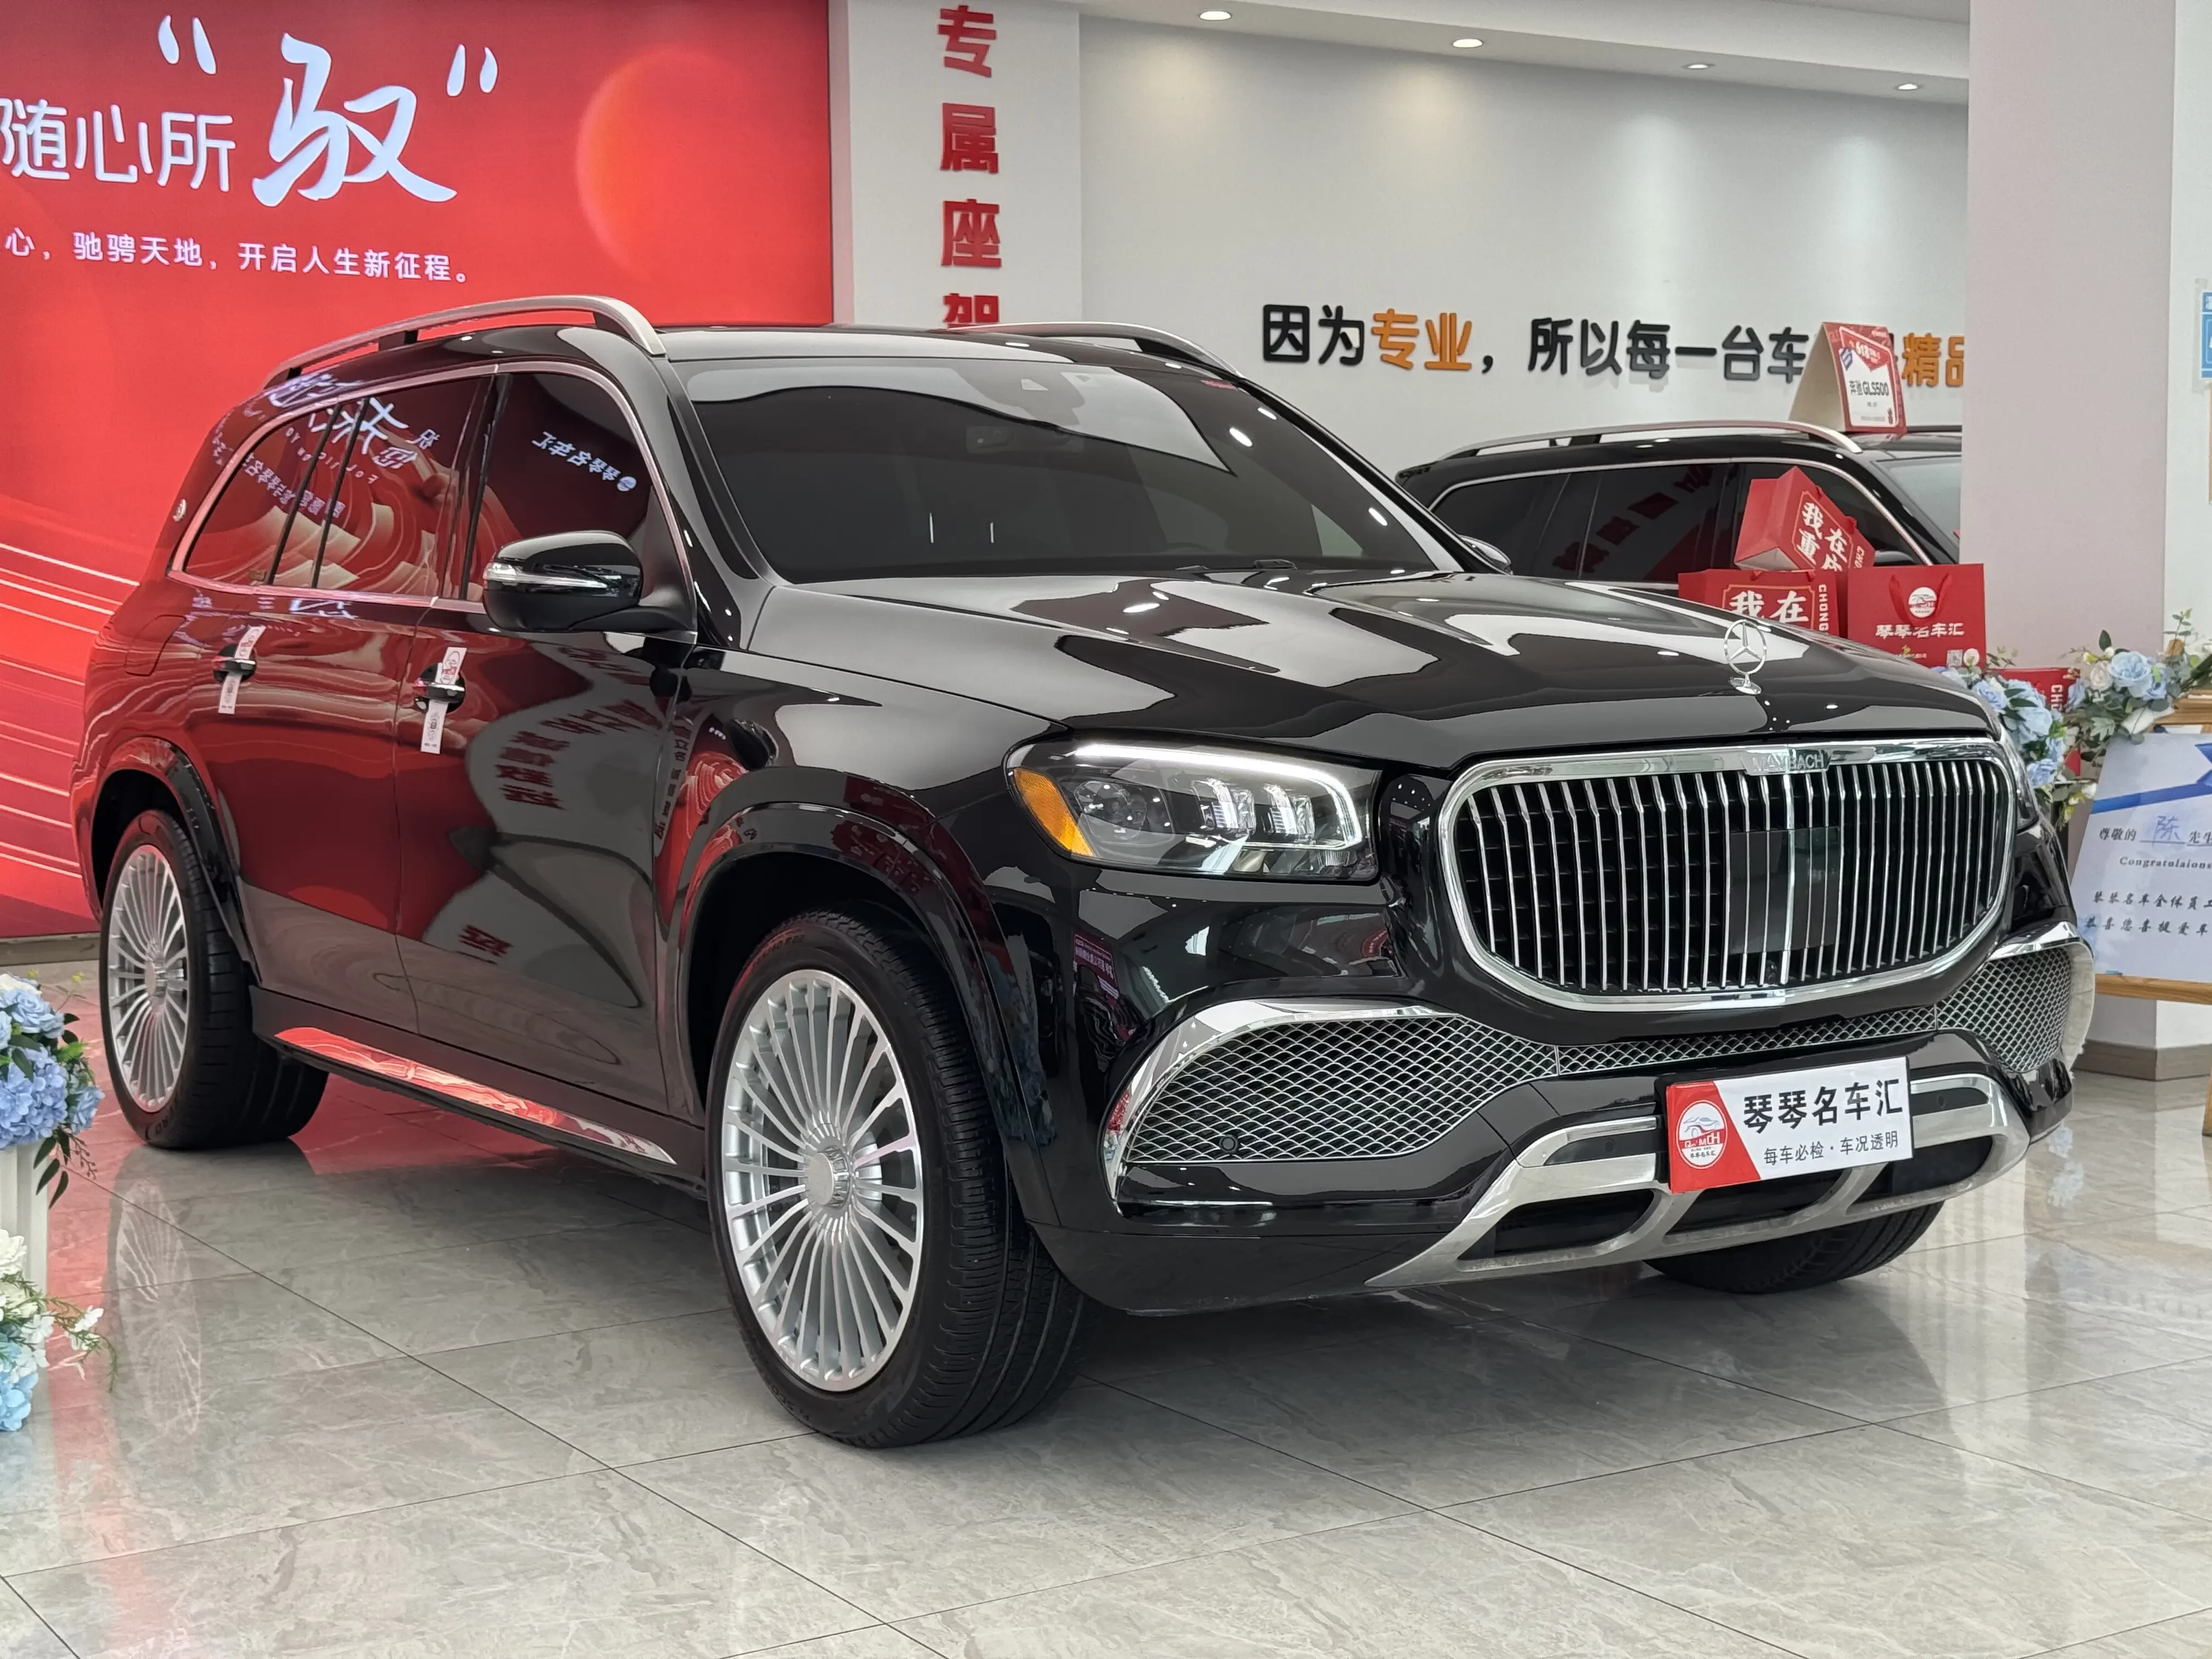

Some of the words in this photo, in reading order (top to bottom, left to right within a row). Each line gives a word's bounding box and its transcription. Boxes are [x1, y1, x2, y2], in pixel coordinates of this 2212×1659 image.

[1753, 752, 1824, 771] MAYBACH
[1743, 1079, 1903, 1134] 琴琴名车汇
